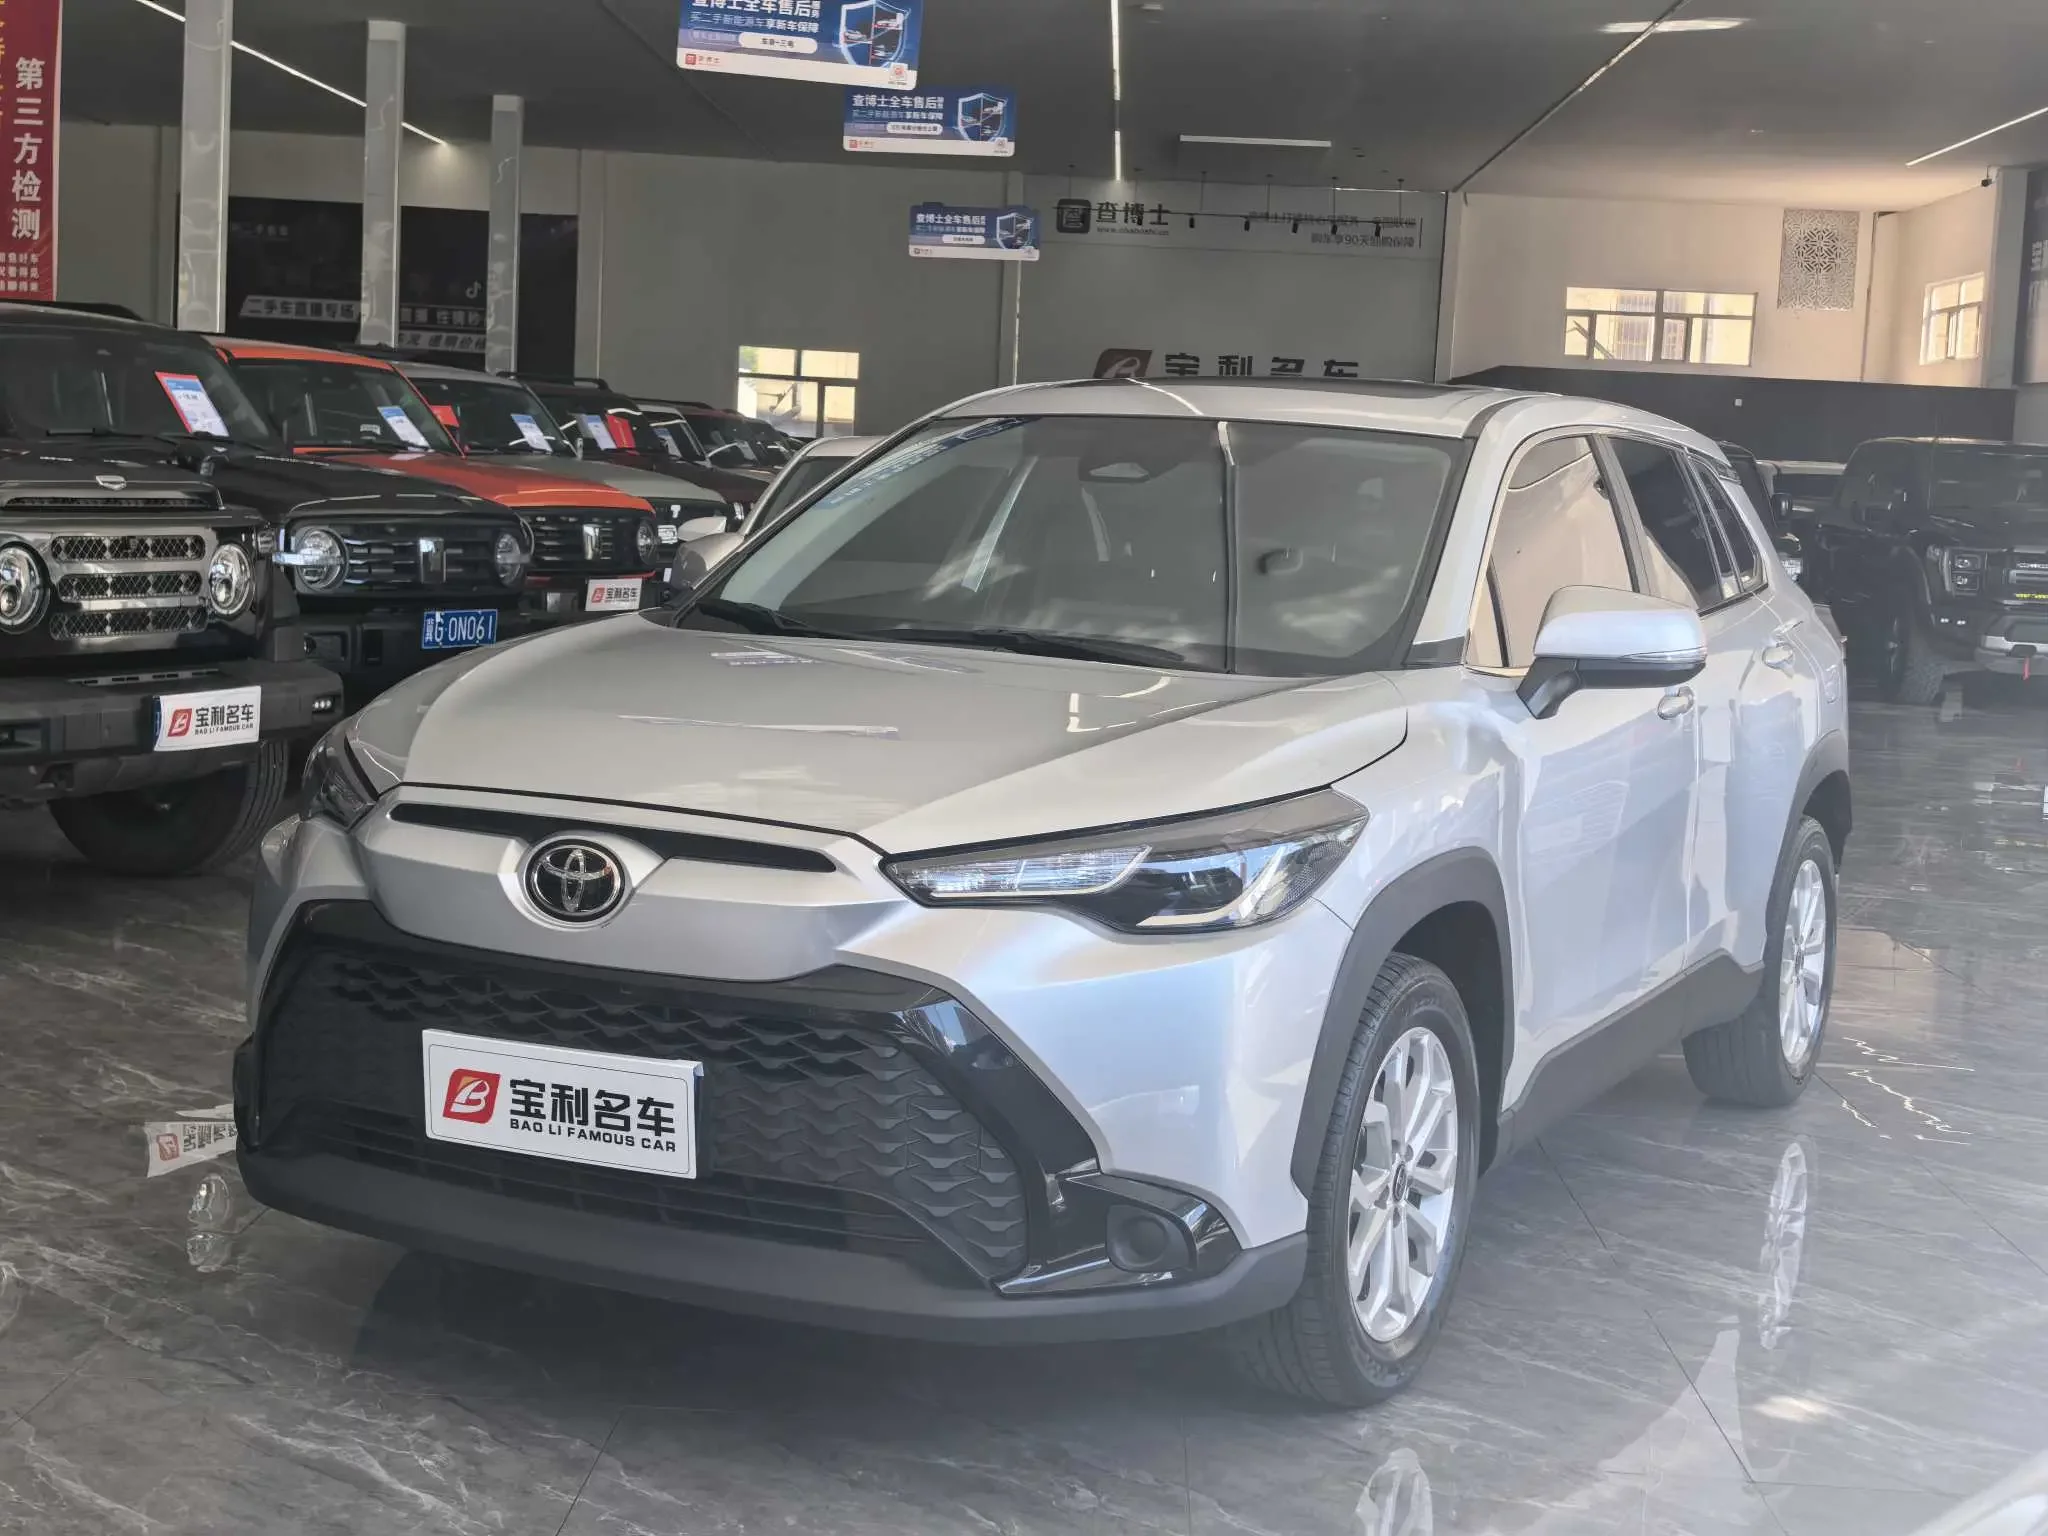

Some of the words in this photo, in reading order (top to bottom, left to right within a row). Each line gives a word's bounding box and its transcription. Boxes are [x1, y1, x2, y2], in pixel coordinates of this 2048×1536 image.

[12, 57, 45, 240] 第三方检测
[1096, 202, 1170, 225] 查博士
[195, 704, 254, 727] 宝利名车
[510, 1079, 675, 1137] 宝利名车
[510, 1118, 543, 1133] BAO
[549, 1124, 561, 1135] LI
[567, 1127, 635, 1147] FAMOUS
[641, 1137, 676, 1152] CAR
